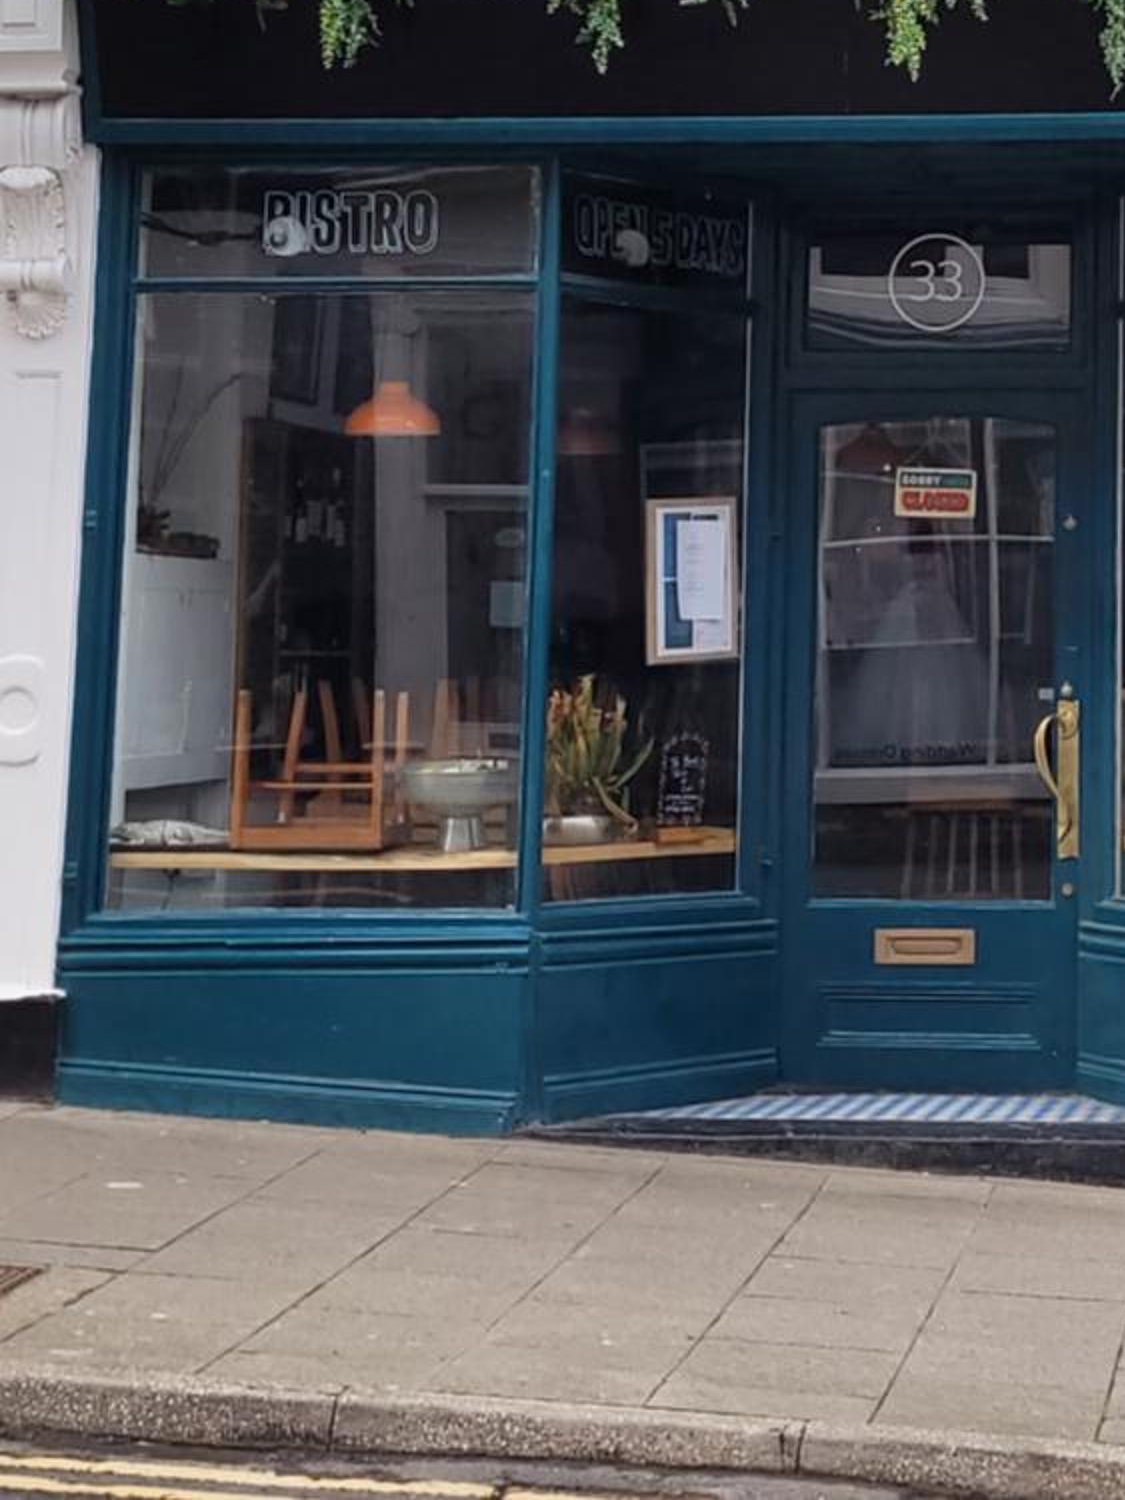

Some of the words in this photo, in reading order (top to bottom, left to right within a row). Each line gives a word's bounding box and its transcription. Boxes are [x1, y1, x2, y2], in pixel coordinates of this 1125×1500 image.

[262, 189, 440, 257] BISTRO
[674, 211, 745, 278] DAYS
[909, 259, 962, 302] 33
